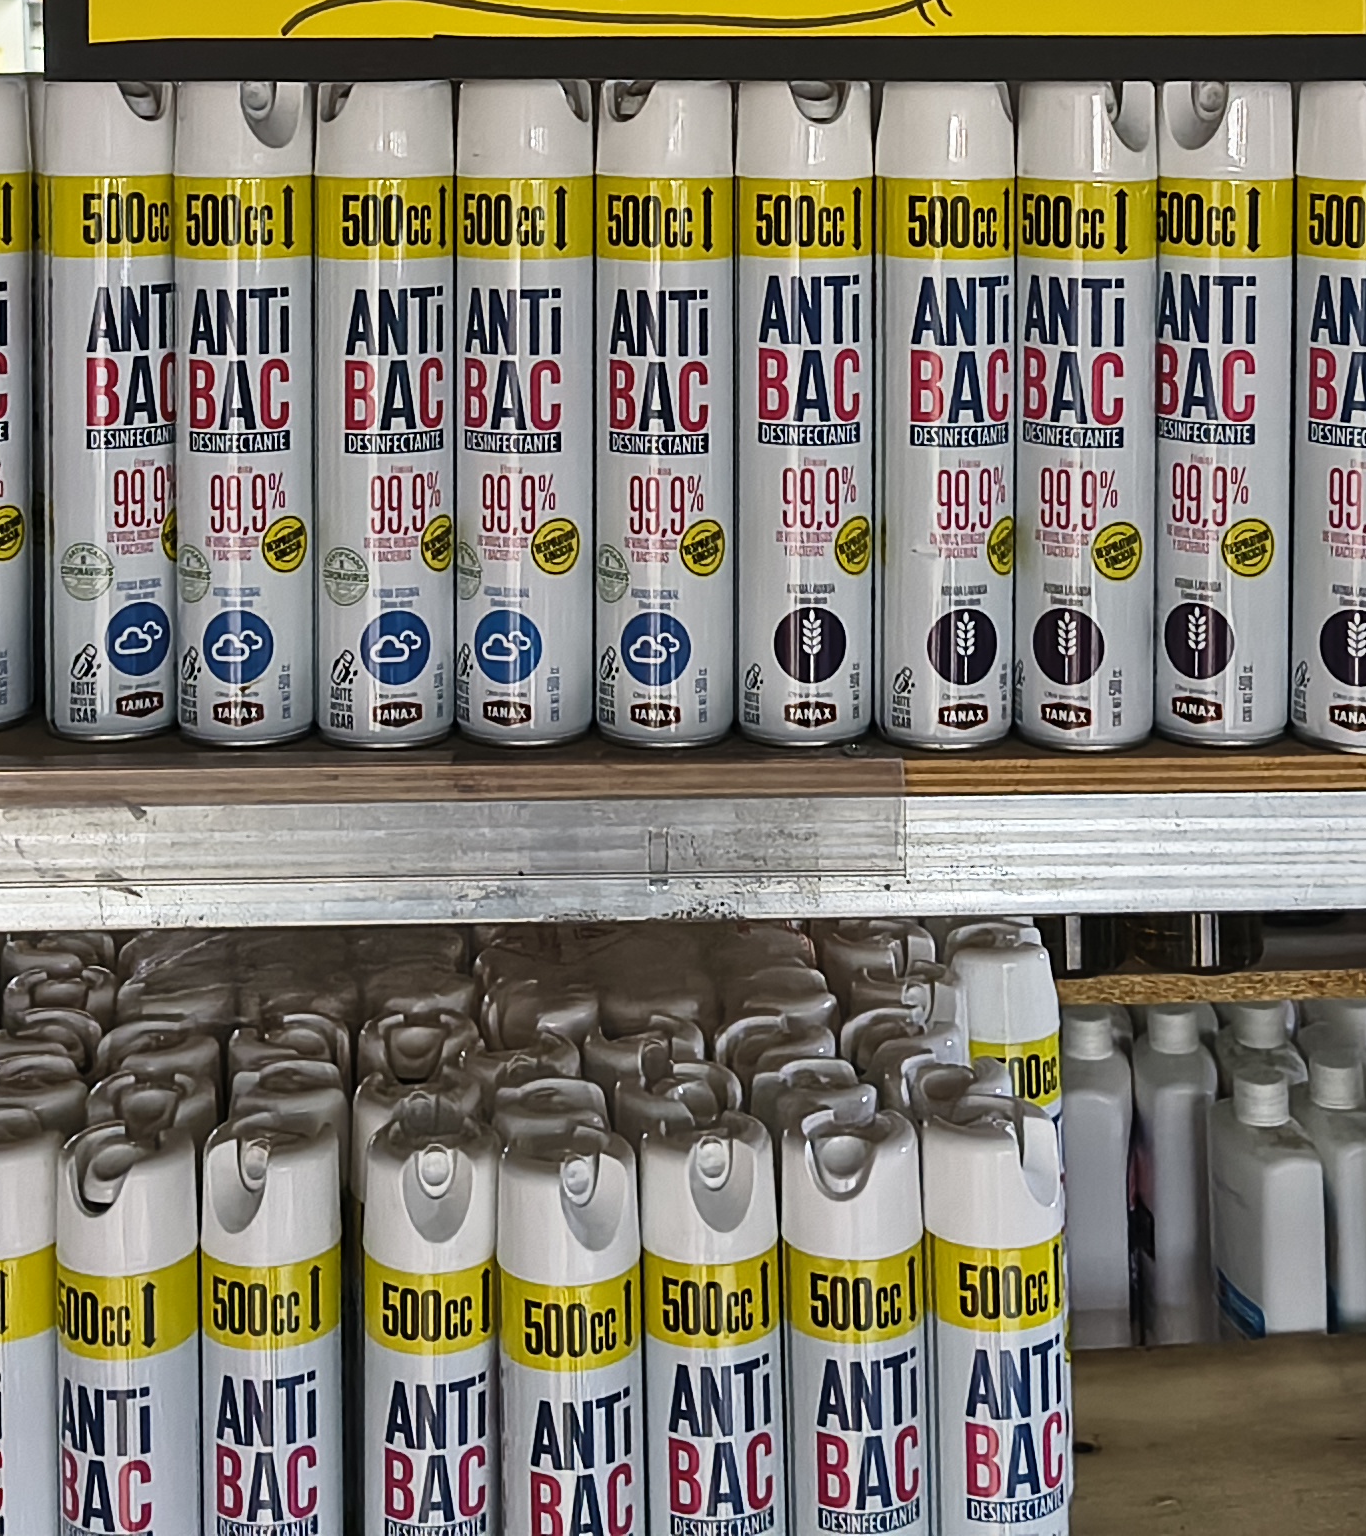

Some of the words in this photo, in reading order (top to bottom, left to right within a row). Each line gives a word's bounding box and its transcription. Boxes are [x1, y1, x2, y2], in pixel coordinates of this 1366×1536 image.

[609, 360, 709, 432] BAC
[190, 430, 290, 453] DESINFECTANTE
[789, 706, 832, 722] TANAX
[661, 1274, 753, 1336] 500cc
[958, 1260, 1049, 1319] 500cc
[816, 1424, 919, 1511] BAC
[965, 1412, 1064, 1499] BAC
[820, 1497, 919, 1533] DESINFECTANTE
[970, 1488, 1064, 1524] DESINFECTANTE
